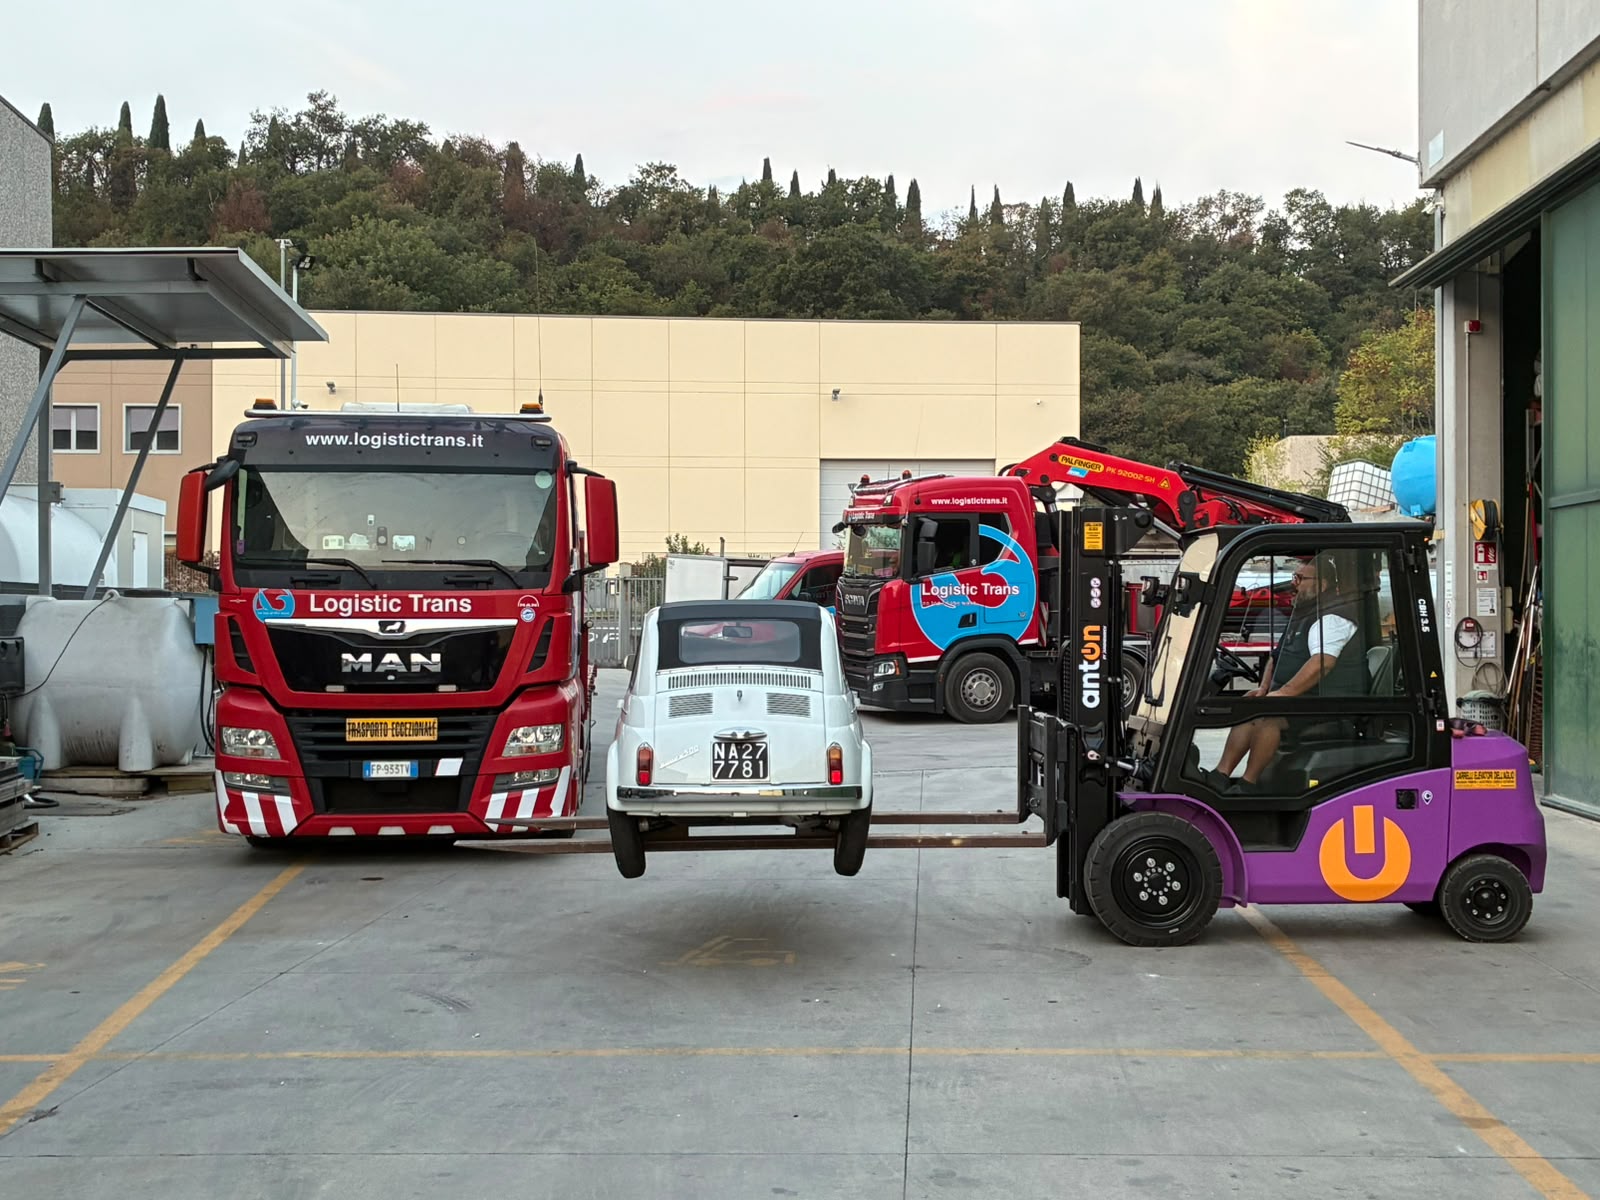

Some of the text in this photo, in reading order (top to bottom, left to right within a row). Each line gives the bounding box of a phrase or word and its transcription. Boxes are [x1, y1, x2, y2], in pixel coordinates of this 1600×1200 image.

[305, 432, 484, 449] www.logistictrans.it
[1061, 455, 1103, 471] PALFINGER
[930, 496, 1008, 507] www.logistictrans.it
[921, 582, 1020, 599] Logistic Trans
[309, 593, 473, 617] Logistic Trans
[340, 652, 442, 674] MAN
[347, 721, 389, 738] TRASPORTO
[713, 760, 764, 778] 7781
